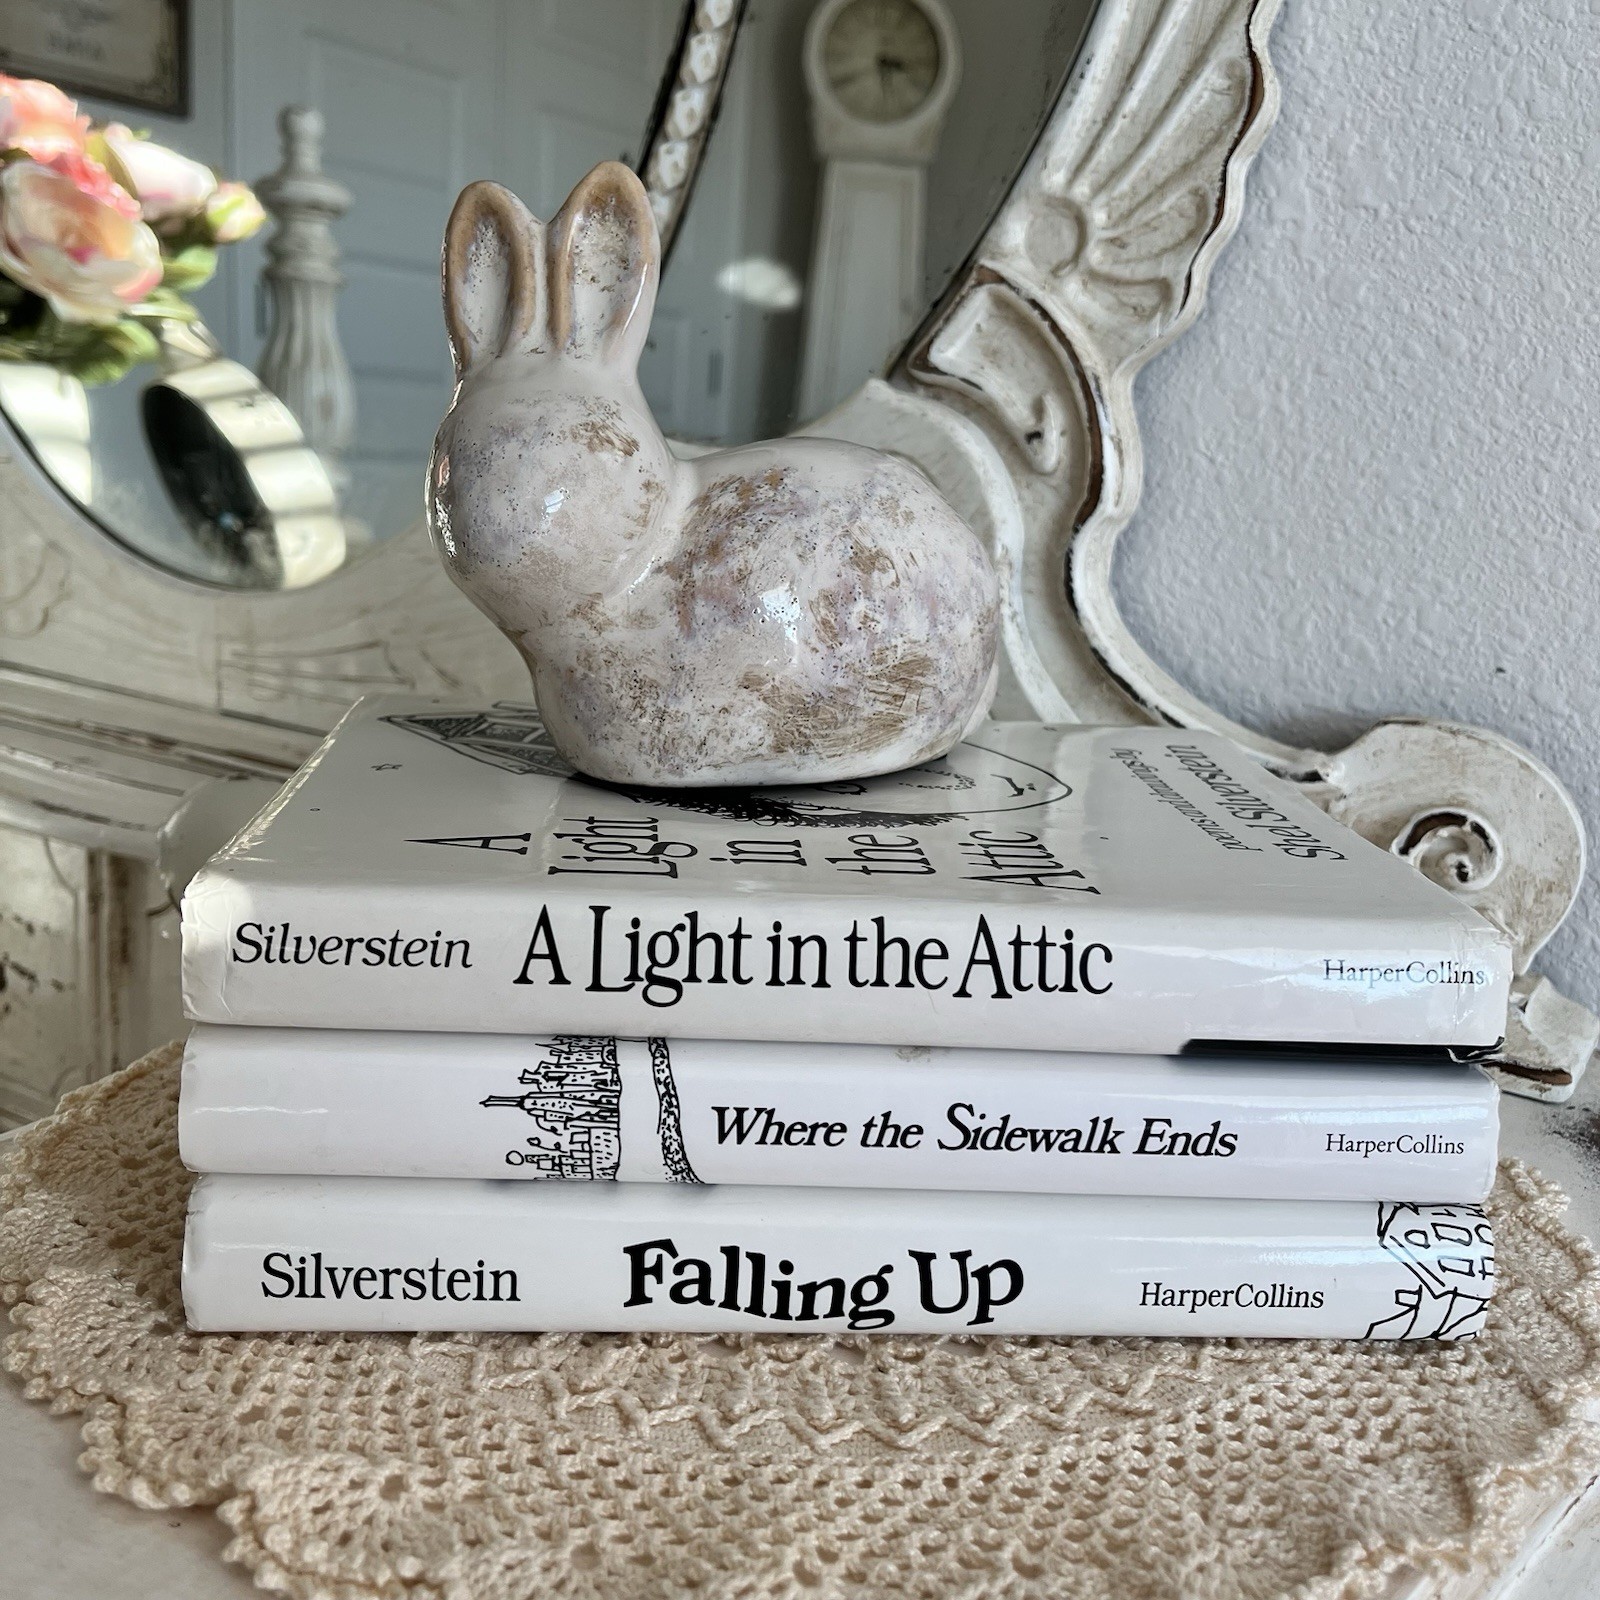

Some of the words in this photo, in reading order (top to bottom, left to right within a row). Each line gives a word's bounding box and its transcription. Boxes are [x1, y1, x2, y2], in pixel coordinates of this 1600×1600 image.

[1109, 747, 1143, 760] by
[1122, 759, 1184, 800] drawings
[1165, 744, 1290, 823] Silverstein
[1157, 799, 1207, 819] and
[404, 831, 532, 856] A
[547, 815, 698, 879] Light
[709, 838, 807, 867] in
[824, 833, 937, 876] the
[1190, 817, 1264, 852] poems
[1244, 823, 1350, 861] Shel
[958, 829, 1101, 894] Attic
[232, 921, 473, 969] Silverstein
[512, 904, 571, 985] A
[585, 905, 754, 1008] Light
[765, 920, 832, 988] in
[844, 916, 949, 990] the
[952, 913, 1113, 999] Attic
[1323, 958, 1485, 989] HarperCollins
[711, 1106, 848, 1148] Where
[860, 1111, 924, 1149] the
[937, 1102, 1124, 1155] Sidewalk
[1132, 1118, 1238, 1157] Ends
[1325, 1133, 1465, 1159] HarperCollins
[261, 1251, 521, 1302] Silverstein
[622, 1238, 896, 1331] Falling
[907, 1248, 1025, 1326] Up
[1139, 1281, 1325, 1314] HarperCollins
